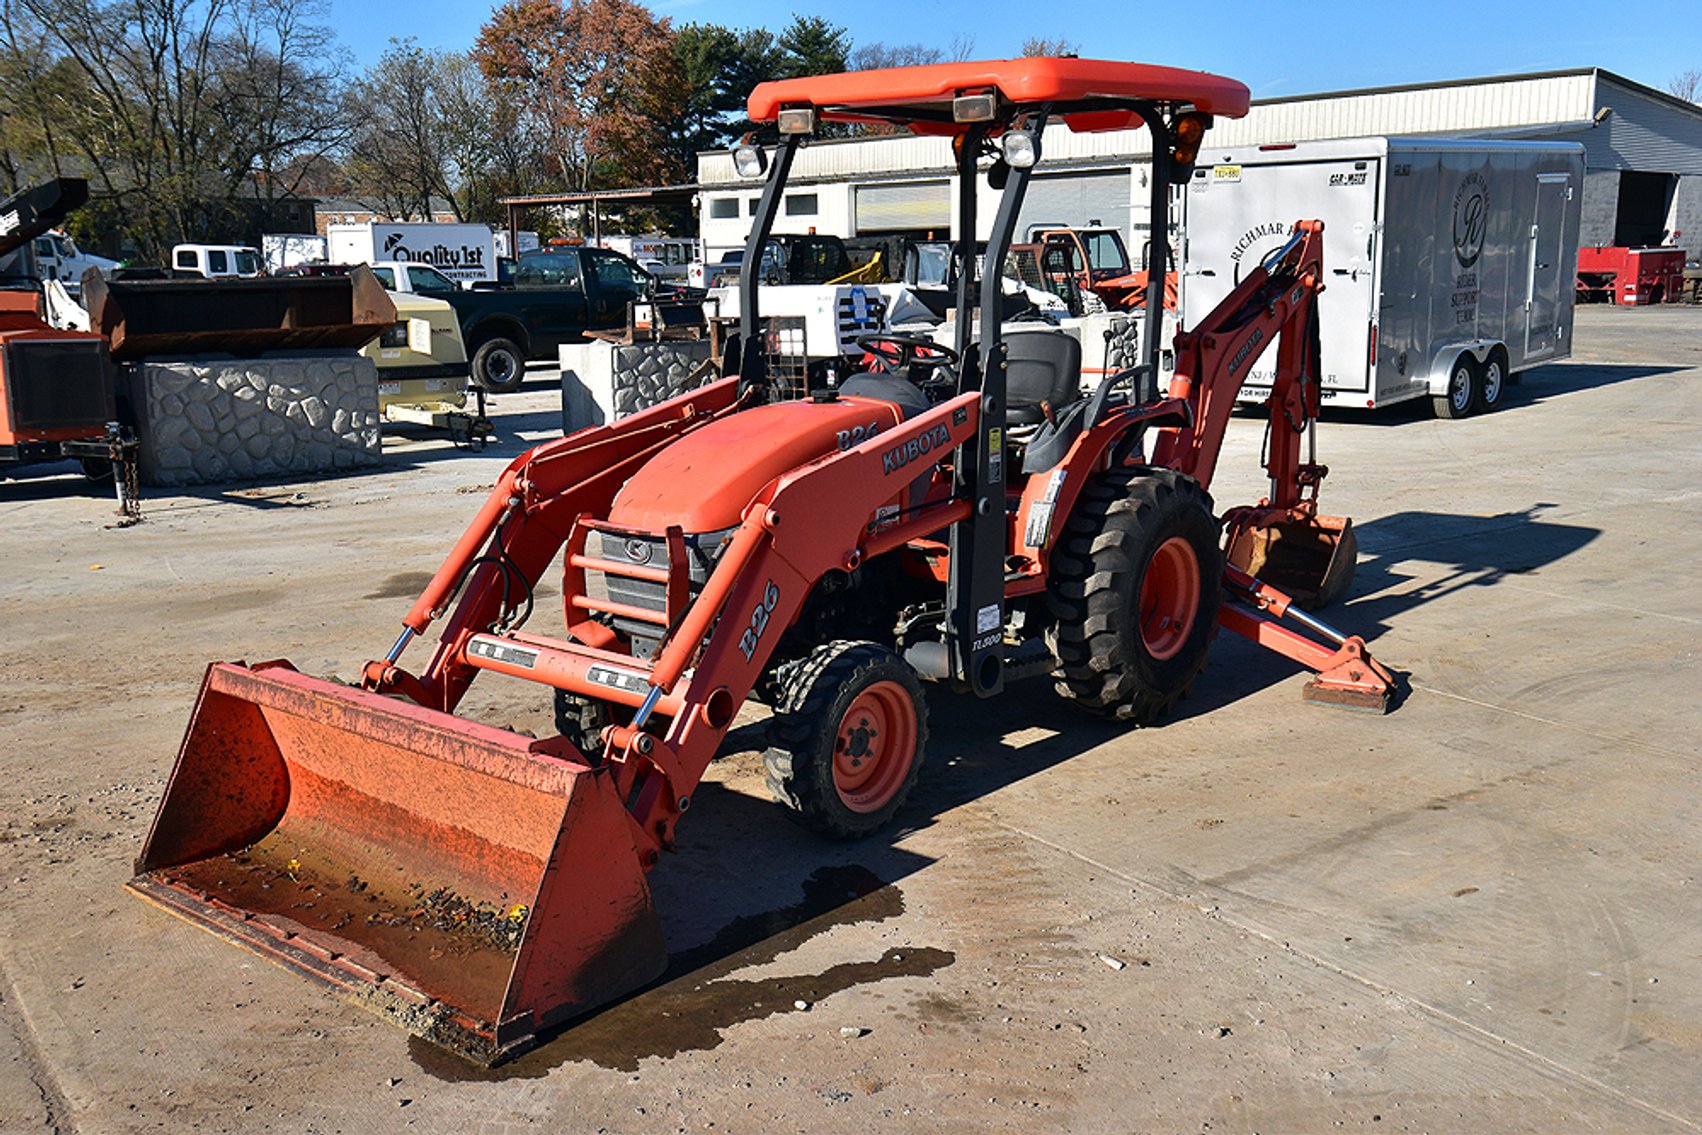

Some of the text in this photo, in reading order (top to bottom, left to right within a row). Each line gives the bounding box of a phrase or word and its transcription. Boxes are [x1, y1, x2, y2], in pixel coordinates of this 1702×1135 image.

[393, 244, 483, 269] Quality 1st
[1230, 222, 1284, 262] RICHMAR
[1227, 327, 1264, 377] KUBOTA
[836, 422, 879, 451] B26
[882, 423, 950, 475] KUBOTA
[738, 579, 780, 664] B26
